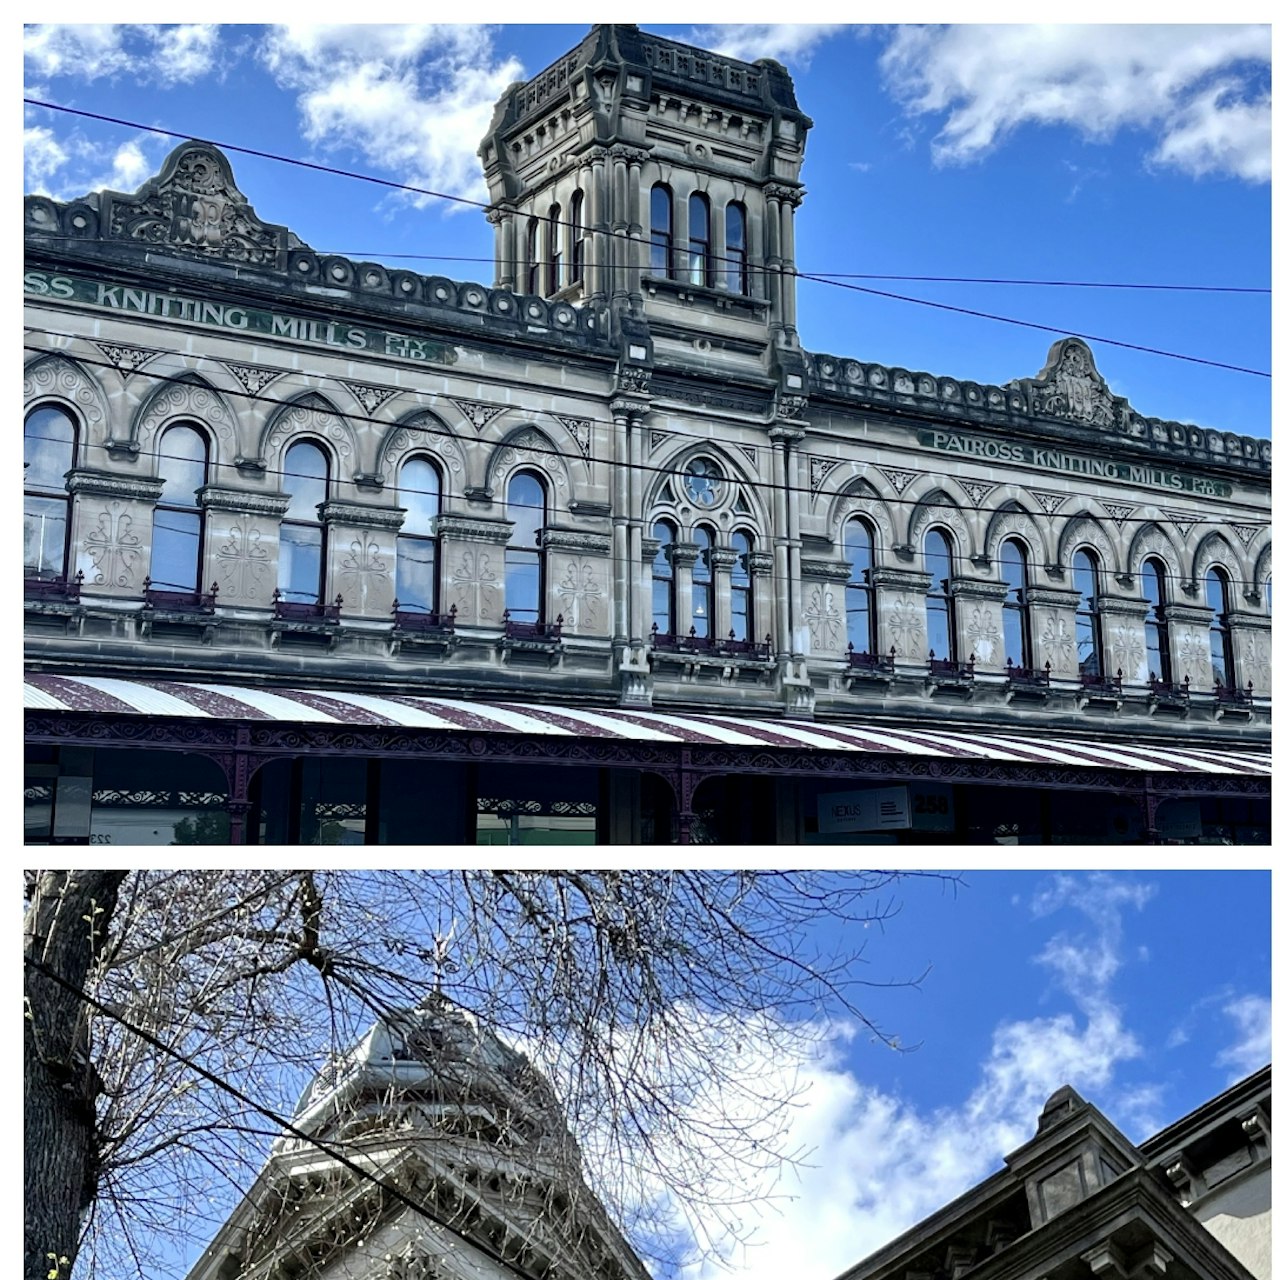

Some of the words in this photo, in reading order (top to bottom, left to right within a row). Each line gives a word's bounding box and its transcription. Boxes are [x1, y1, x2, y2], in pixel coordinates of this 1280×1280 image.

[96, 284, 248, 330] KNITTING
[270, 314, 367, 349] MILLS
[385, 335, 430, 350] PTY
[932, 432, 1025, 461] PATROSS
[1033, 449, 1119, 478] KNITTING
[1129, 466, 1183, 489] MILLS
